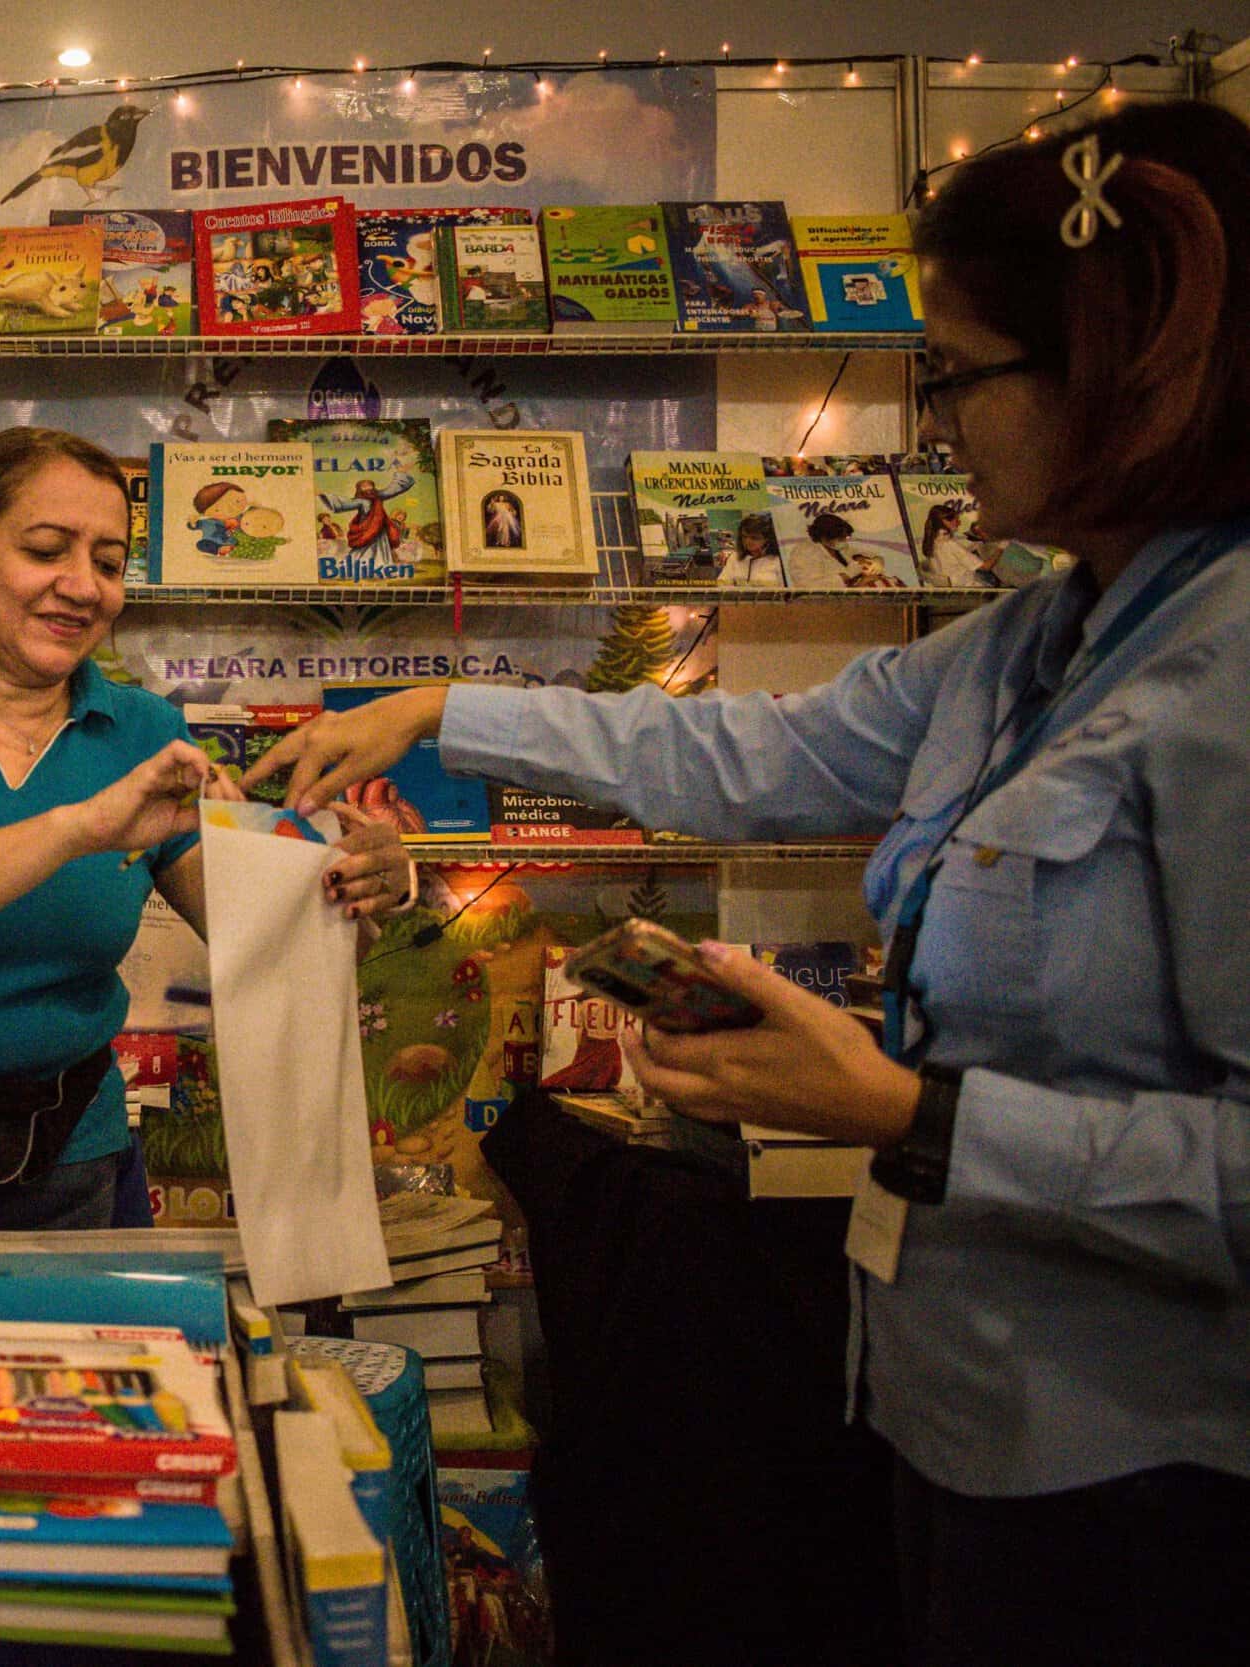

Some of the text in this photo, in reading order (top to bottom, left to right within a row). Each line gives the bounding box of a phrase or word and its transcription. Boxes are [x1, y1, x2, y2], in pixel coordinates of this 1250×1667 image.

[170, 142, 527, 191] BIENVENIDOS
[204, 213, 265, 230] Cuentos
[363, 240, 398, 248] BORRA
[465, 243, 515, 254] BARDA
[557, 271, 668, 286] MATEMÁTICAS
[604, 286, 670, 299] GALDÓS
[521, 444, 541, 454] La
[208, 455, 228, 463] ser
[230, 452, 242, 463] el
[244, 452, 303, 463] hermano
[469, 452, 562, 469] Sagrada
[668, 462, 732, 476] MANUAL
[501, 471, 563, 487] Biblia
[644, 476, 761, 491] URGENCIAS MÉDICAS
[782, 483, 886, 500] HIGIENE ORAL
[673, 493, 738, 508] Nelara
[798, 499, 871, 518] Nelara
[165, 656, 287, 680] NELARA
[297, 655, 450, 678] EDITORES
[504, 808, 561, 821] médica
[519, 826, 571, 838] LANGE
[508, 1011, 526, 1036] A
[483, 1106, 499, 1128] D
